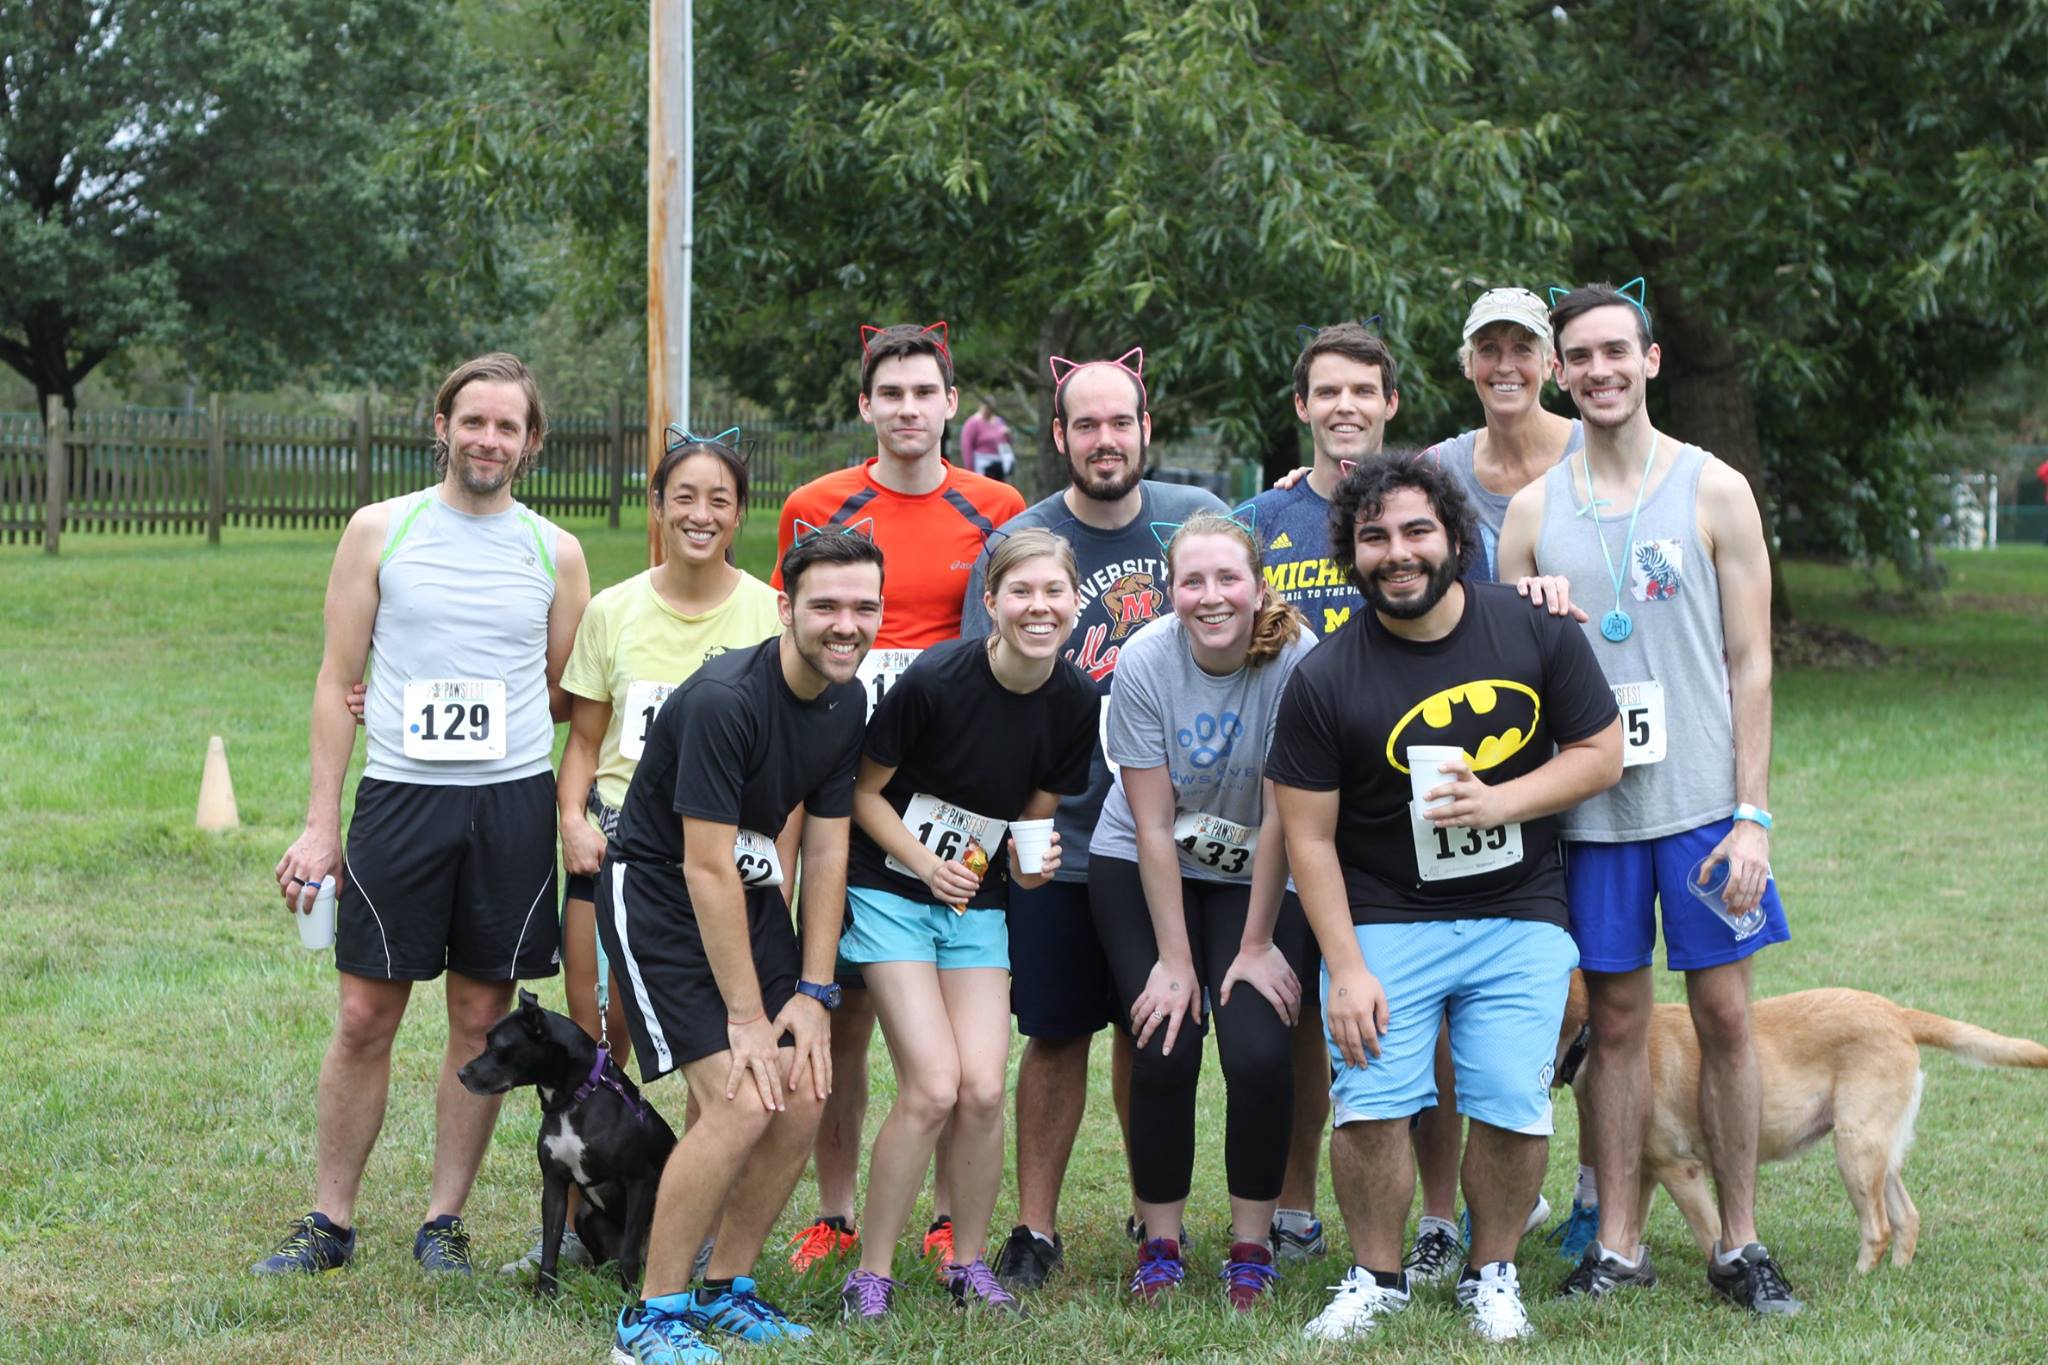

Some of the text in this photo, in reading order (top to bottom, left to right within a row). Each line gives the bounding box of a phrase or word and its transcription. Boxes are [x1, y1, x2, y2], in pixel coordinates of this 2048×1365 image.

[1120, 590, 1154, 623] M
[1307, 589, 1321, 599] TO
[1325, 586, 1345, 598] THE
[1323, 607, 1351, 634] M
[444, 682, 484, 699] PAWSFEST
[421, 703, 490, 741] 129
[1620, 707, 1650, 747] 5
[946, 807, 990, 834] PAWSFEST
[918, 821, 981, 862] 16
[736, 853, 773, 887] 62
